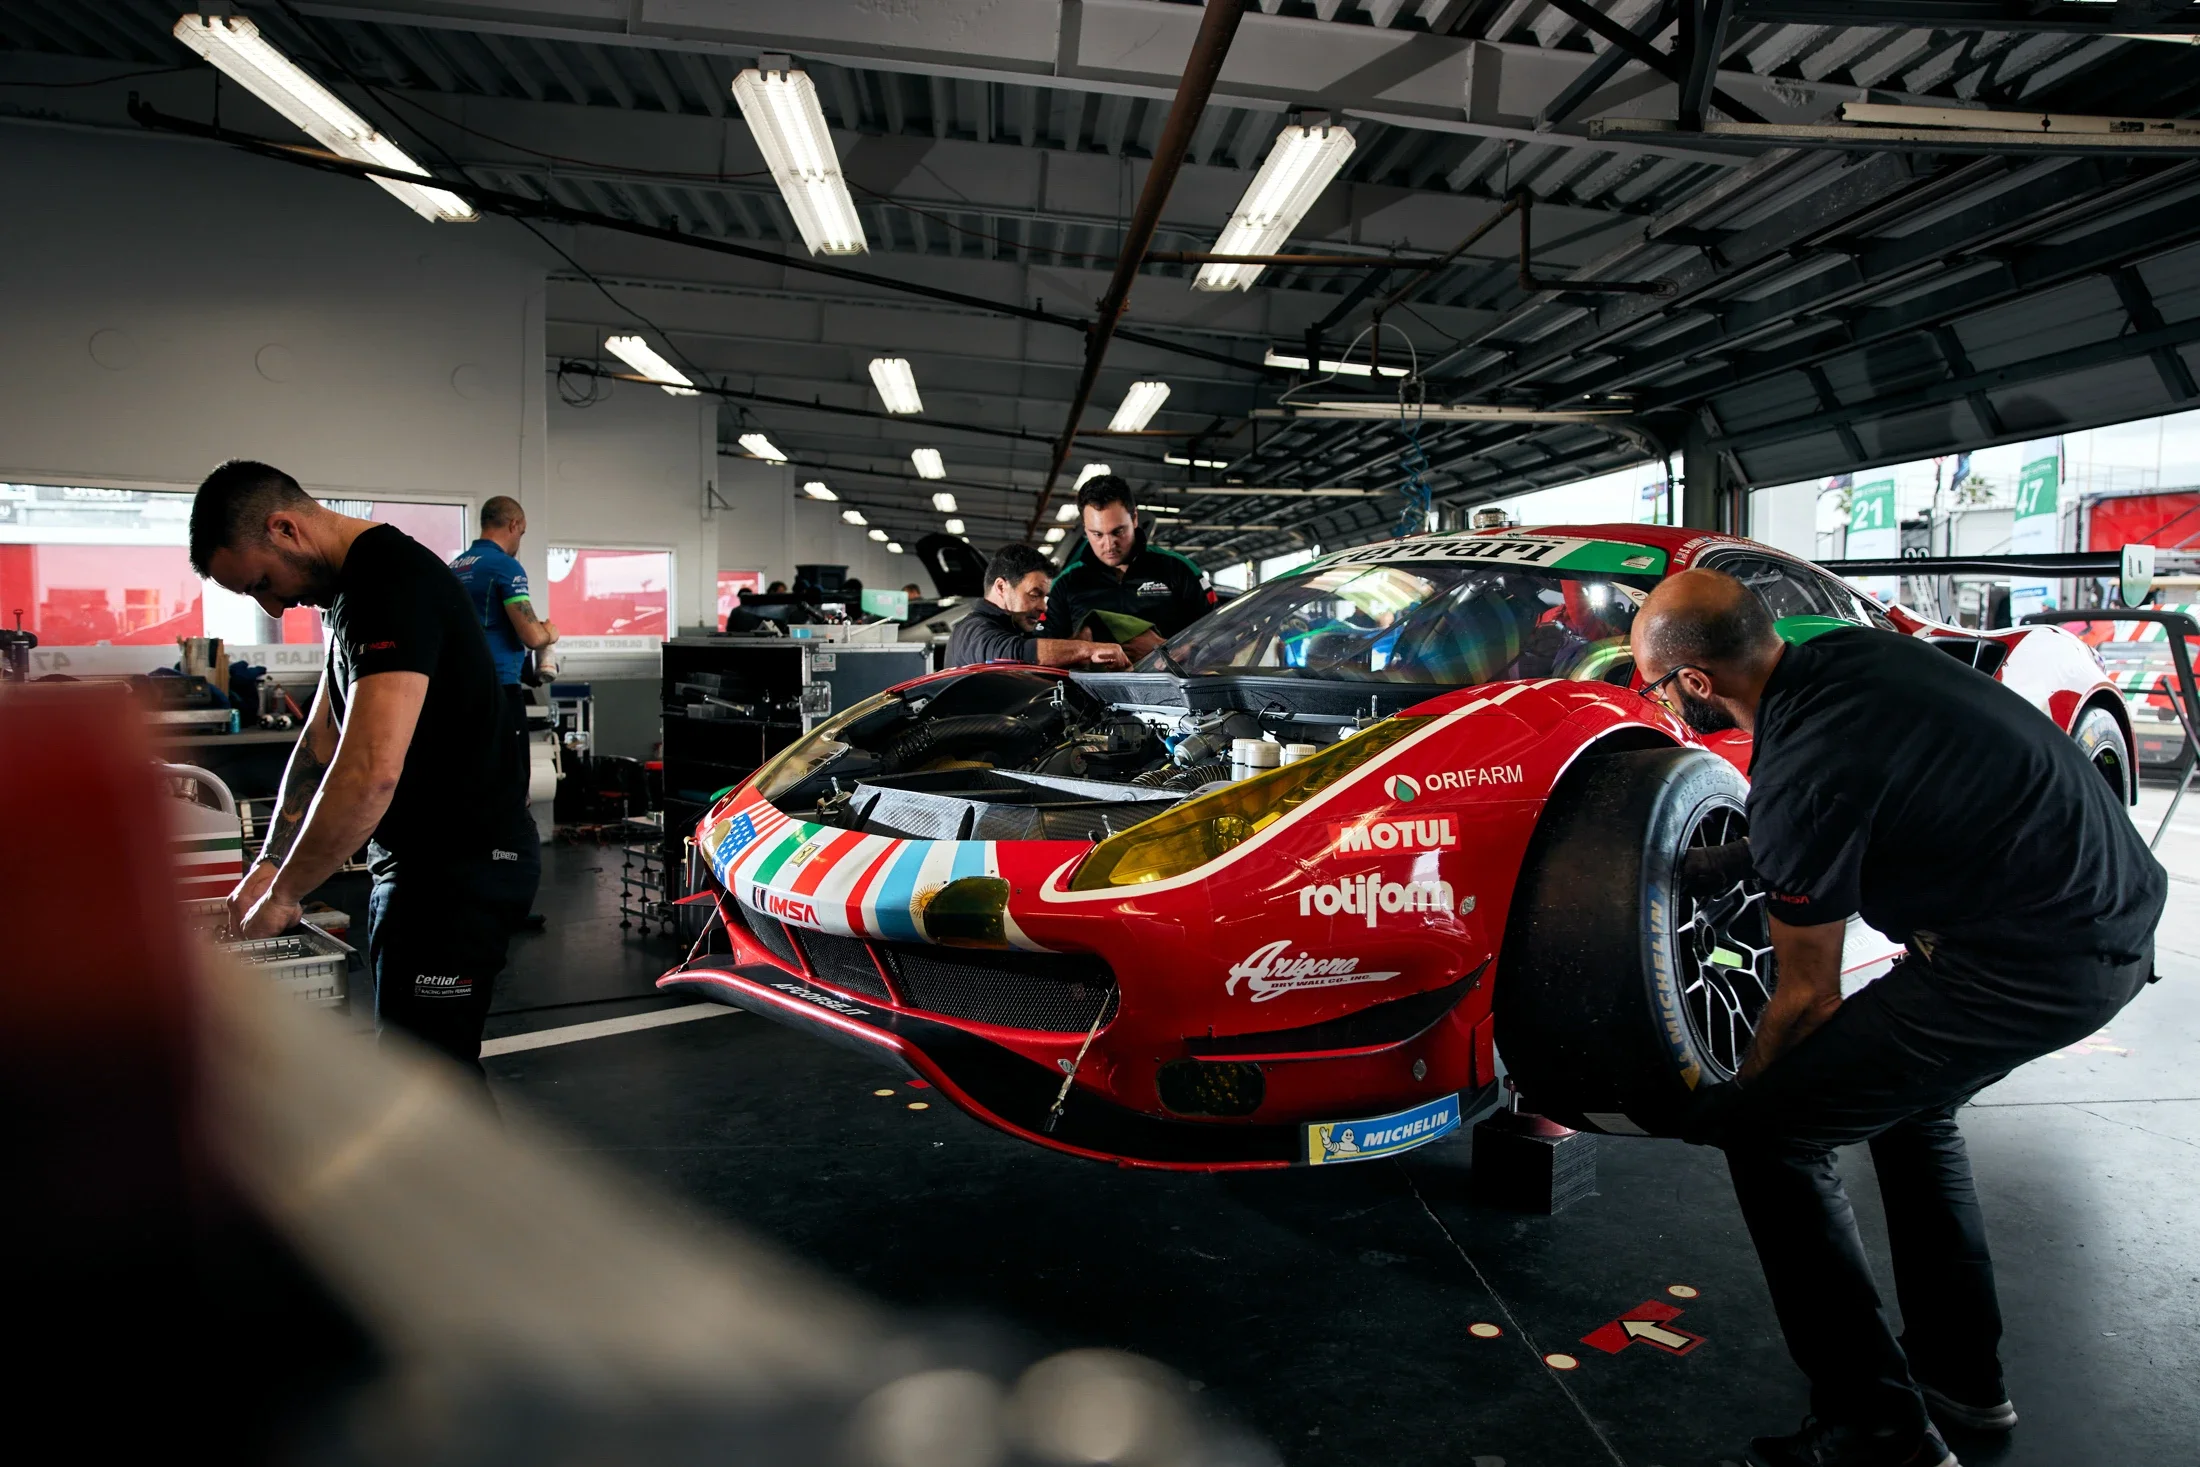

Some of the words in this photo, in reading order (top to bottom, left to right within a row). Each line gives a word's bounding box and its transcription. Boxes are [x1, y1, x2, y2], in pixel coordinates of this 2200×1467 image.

[1853, 496, 1883, 530] 21
[2016, 477, 2043, 515] 47
[1425, 764, 1523, 792] ORIFARM
[1339, 818, 1456, 853] MOTUL
[769, 895, 820, 926] IMSA
[1300, 872, 1454, 928] rotiform
[415, 974, 459, 986] Cetilar
[1296, 979, 1326, 987] WALL
[1651, 900, 1682, 1045] MICHELIN
[1363, 1110, 1449, 1147] MICHELIN
